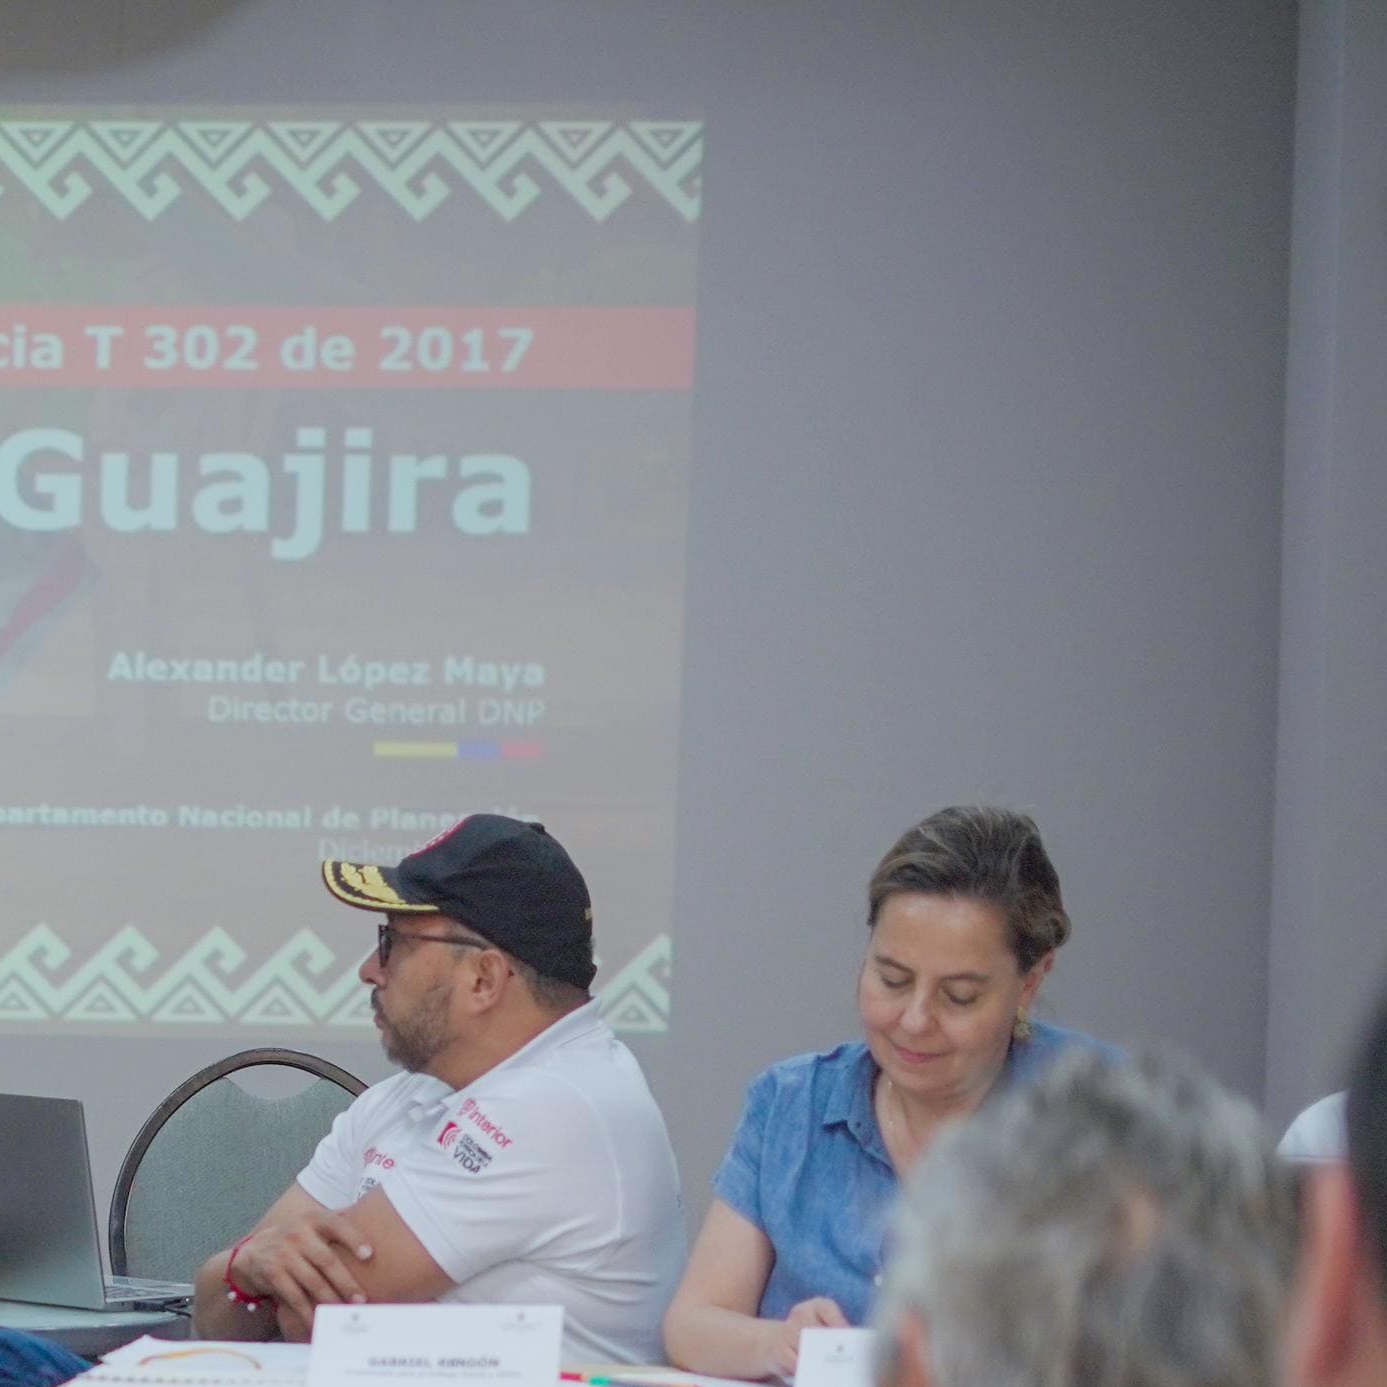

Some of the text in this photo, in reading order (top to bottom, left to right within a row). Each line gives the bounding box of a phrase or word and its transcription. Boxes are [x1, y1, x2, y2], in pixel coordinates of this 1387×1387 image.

[85, 326, 123, 369] T
[143, 325, 258, 370] 302
[280, 327, 356, 371] de
[379, 327, 535, 372] 2017
[107, 652, 545, 690] Alexander López Maya
[208, 697, 545, 724] Director General DNP
[178, 805, 313, 828] Nacional
[322, 806, 360, 829] de
[468, 1106, 514, 1149] Interior
[452, 1145, 482, 1174] VIDA
[367, 1356, 431, 1367] GABRIEL
